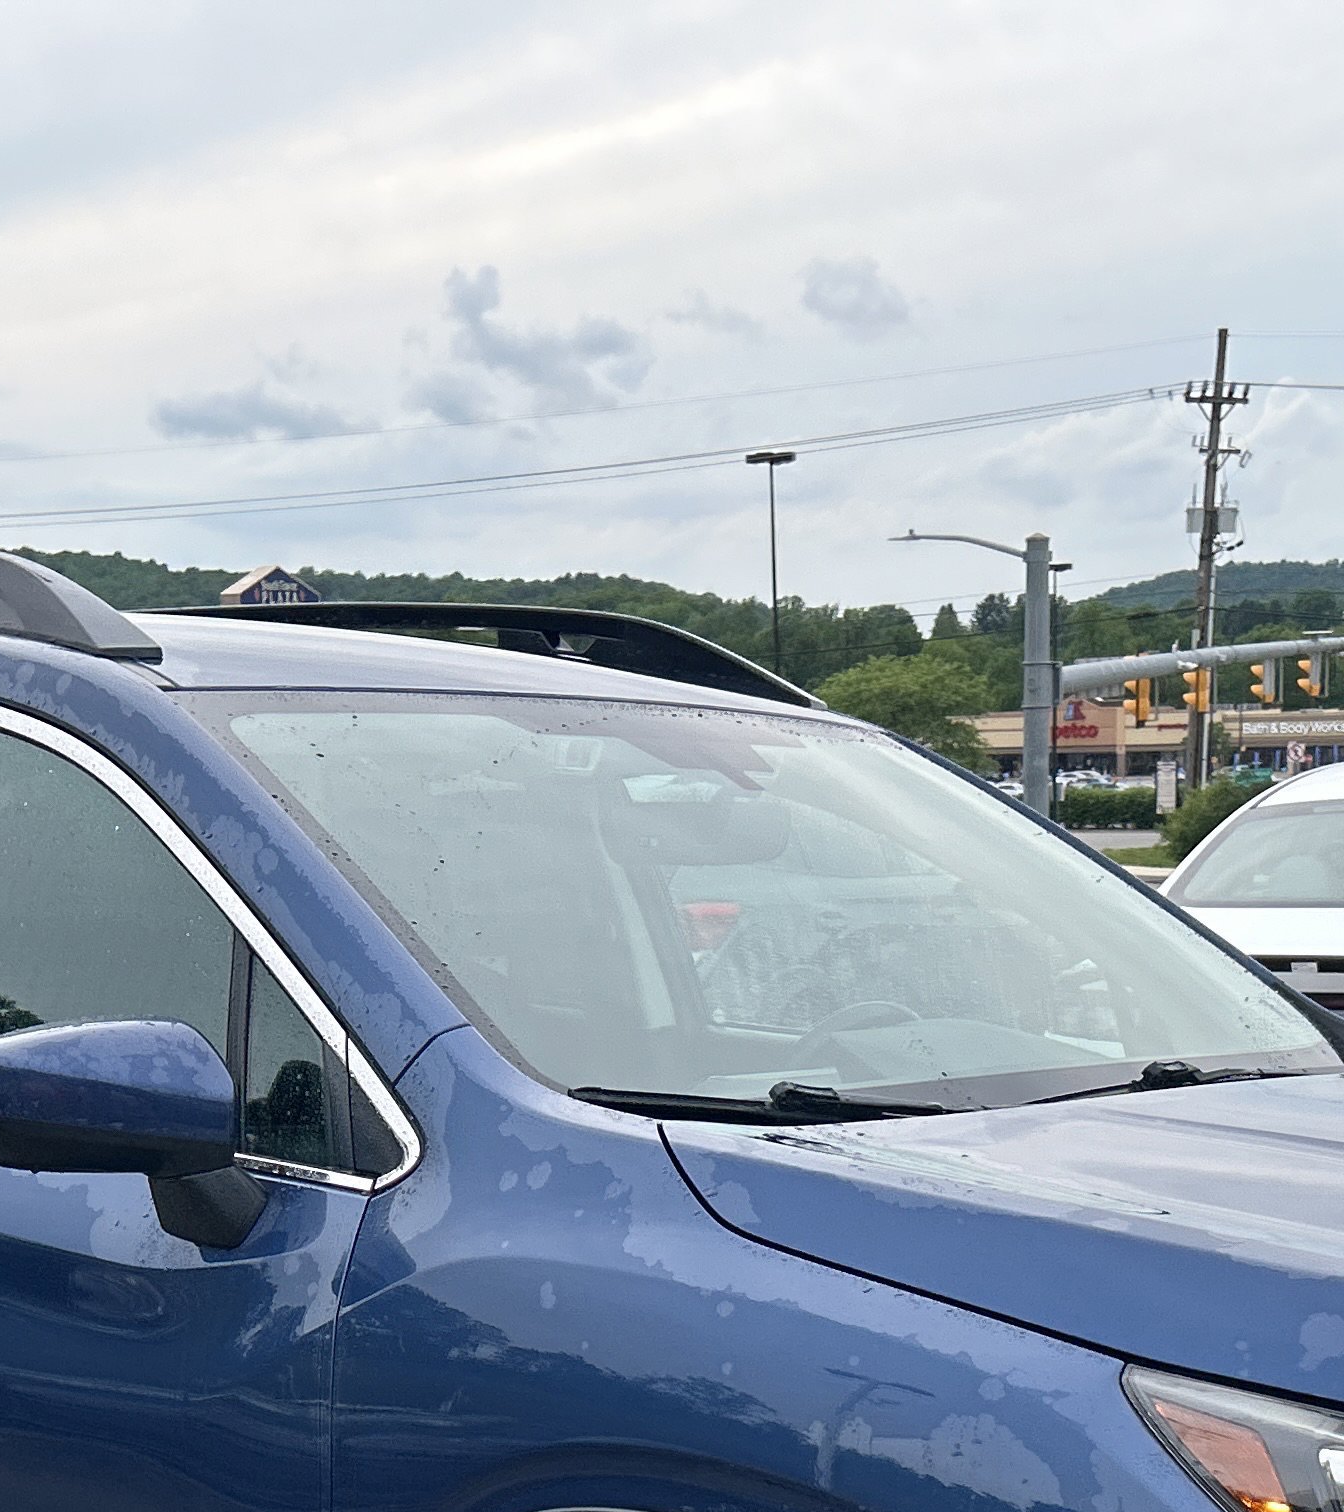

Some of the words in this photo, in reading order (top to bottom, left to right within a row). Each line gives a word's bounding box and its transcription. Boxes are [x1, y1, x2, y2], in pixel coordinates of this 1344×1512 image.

[1242, 722, 1268, 734] Bath
[1270, 722, 1278, 734] &
[1279, 722, 1310, 735] Body
